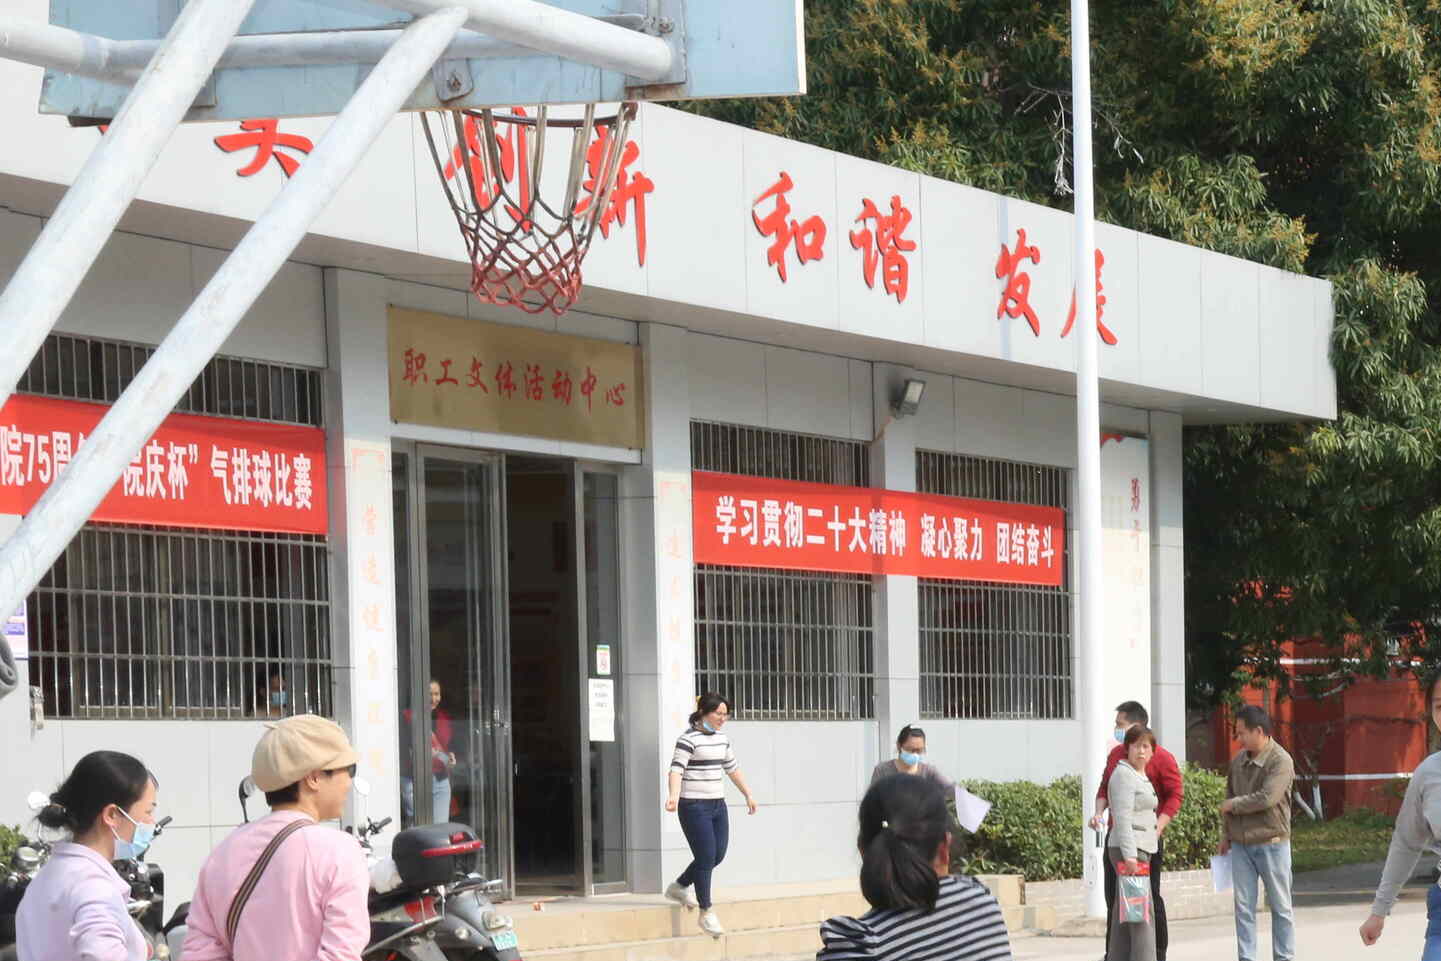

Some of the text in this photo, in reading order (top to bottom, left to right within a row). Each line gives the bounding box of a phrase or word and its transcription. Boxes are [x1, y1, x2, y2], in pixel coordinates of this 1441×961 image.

[752, 171, 917, 304] 和谐
[402, 347, 626, 416] 职工文体活动中心
[210, 444, 312, 510] 气排球比赛
[715, 495, 1054, 568] 学习贯彻二十大精神 凝心聚力 团结奋斗
